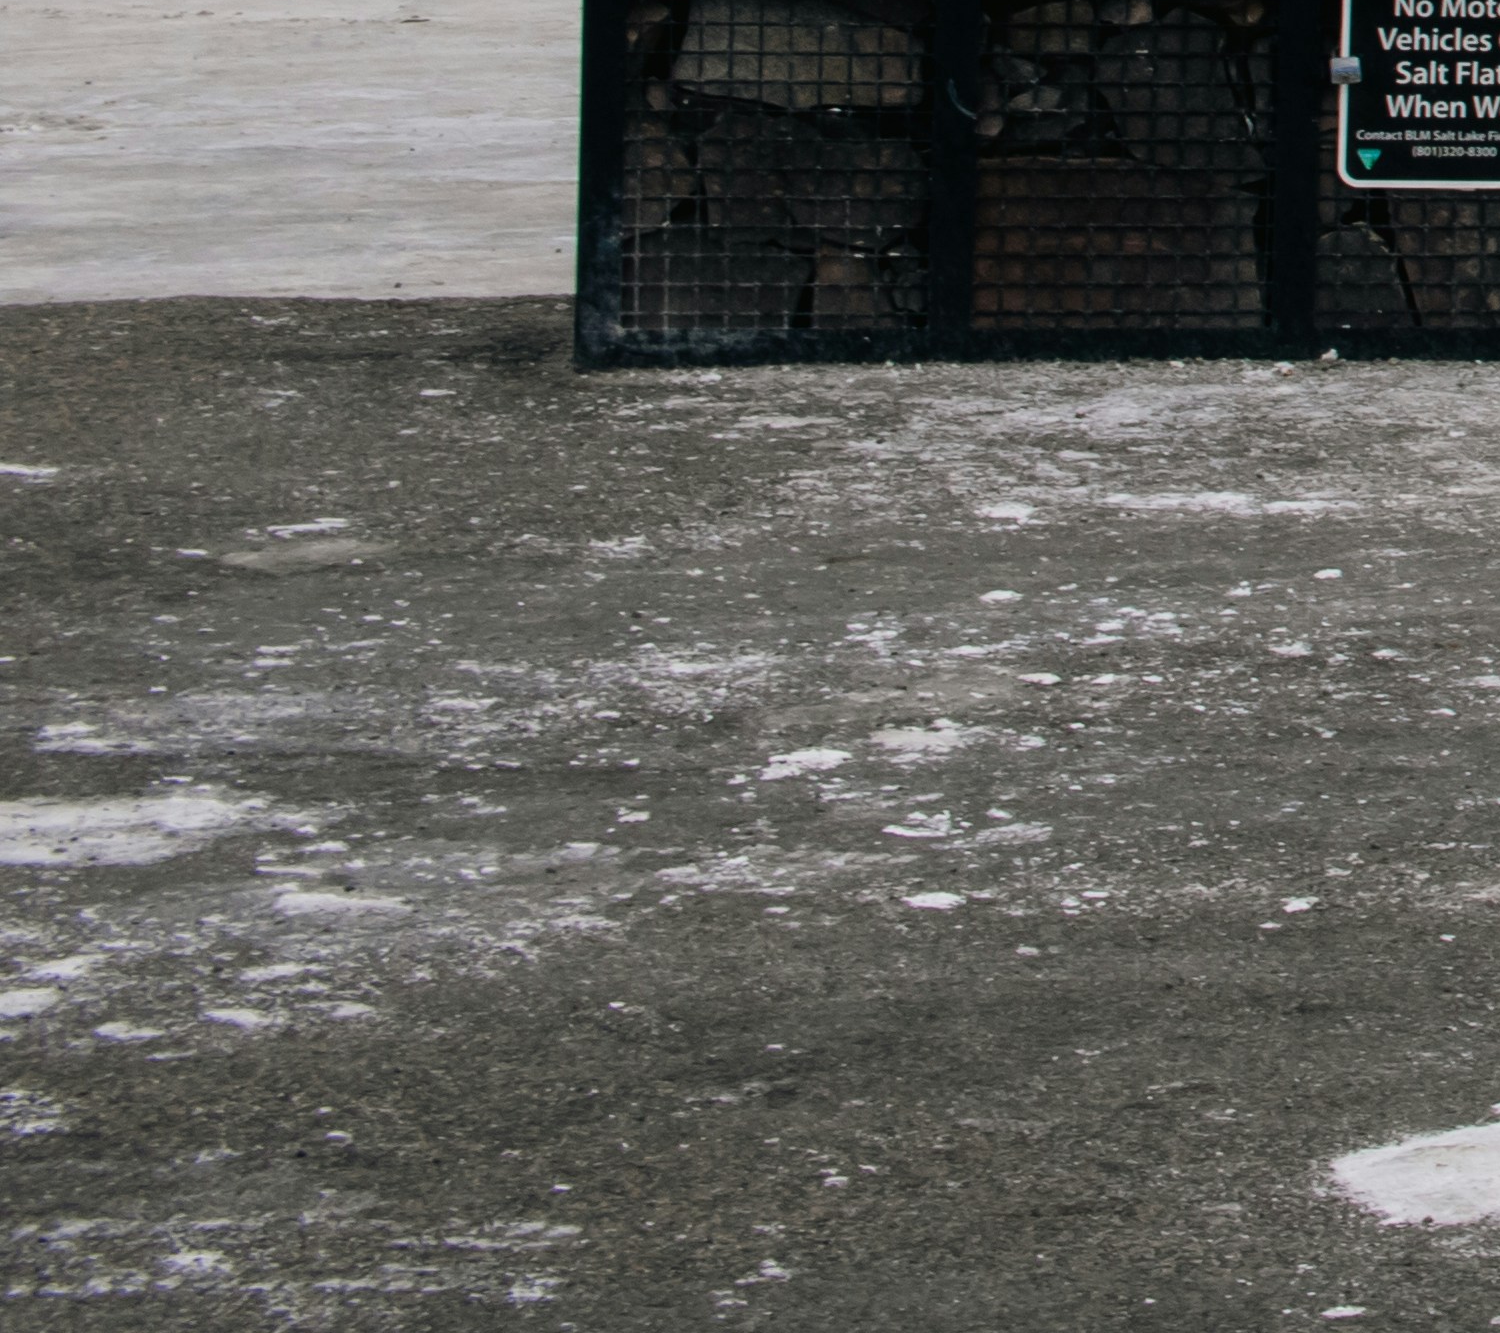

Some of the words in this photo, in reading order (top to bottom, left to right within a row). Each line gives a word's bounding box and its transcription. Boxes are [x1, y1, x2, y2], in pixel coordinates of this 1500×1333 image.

[1377, 26, 1492, 52] Vehicles
[1395, 60, 1449, 85] Salt
[1386, 93, 1466, 119] When
[1356, 129, 1403, 141] Contact
[1404, 130, 1431, 141] BLM
[1432, 130, 1456, 141] Salt
[1457, 131, 1487, 142] Lake
[1411, 146, 1498, 158] (801)320-8300
